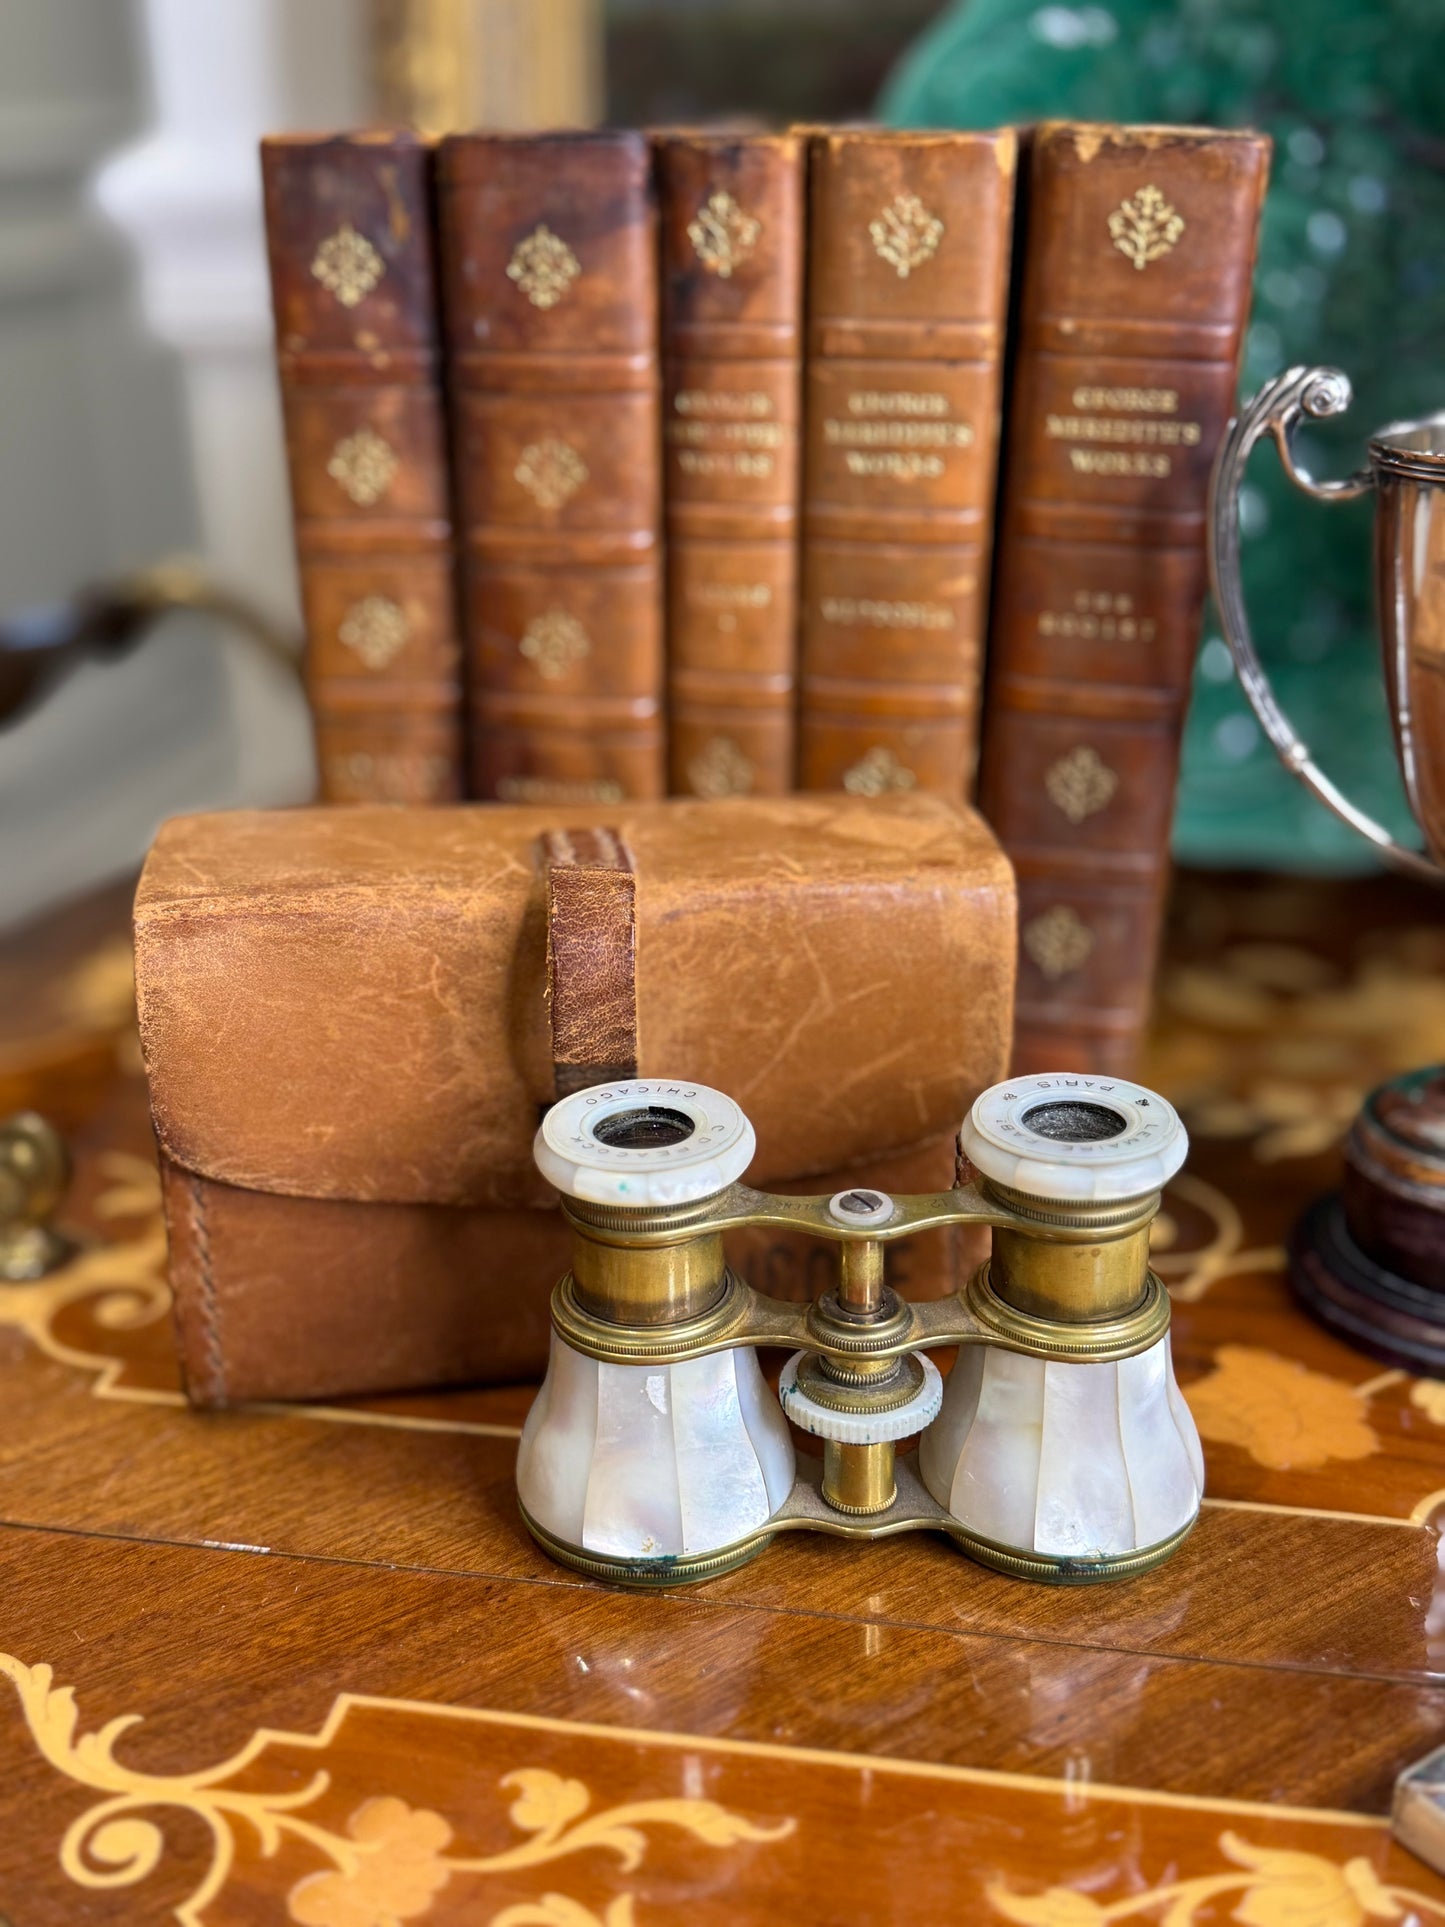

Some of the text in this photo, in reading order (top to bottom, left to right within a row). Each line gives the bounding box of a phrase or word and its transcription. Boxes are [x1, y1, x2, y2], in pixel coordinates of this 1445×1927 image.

[1072, 387, 1178, 413] GEORGE
[1070, 449, 1170, 477] WORKS
[586, 1086, 697, 1105] CHICAGO
[1037, 1080, 1116, 1092] PARIS
[570, 1135, 690, 1158] PEACOCK
[1062, 1123, 1159, 1152] LEMAIRE
